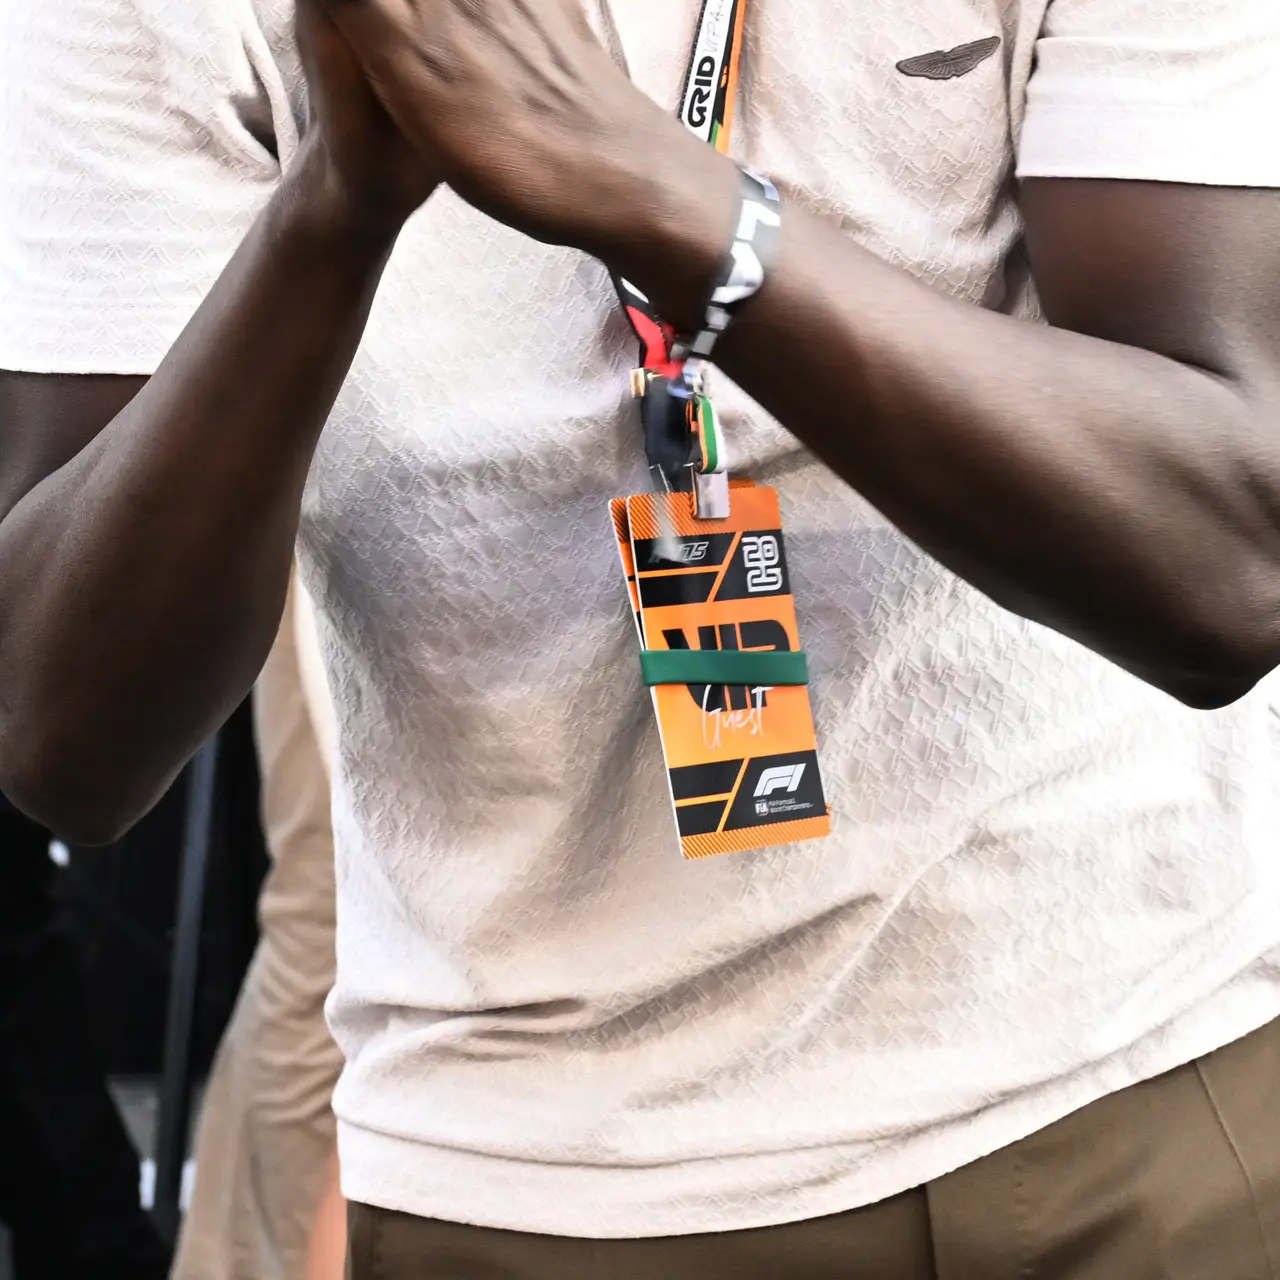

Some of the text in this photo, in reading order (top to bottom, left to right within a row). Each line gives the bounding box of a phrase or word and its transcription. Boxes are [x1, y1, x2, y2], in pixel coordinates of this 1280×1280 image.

[688, 55, 716, 128] GRID
[662, 619, 791, 712] VIP
[701, 684, 774, 750] Guest
[752, 763, 807, 797] F1
